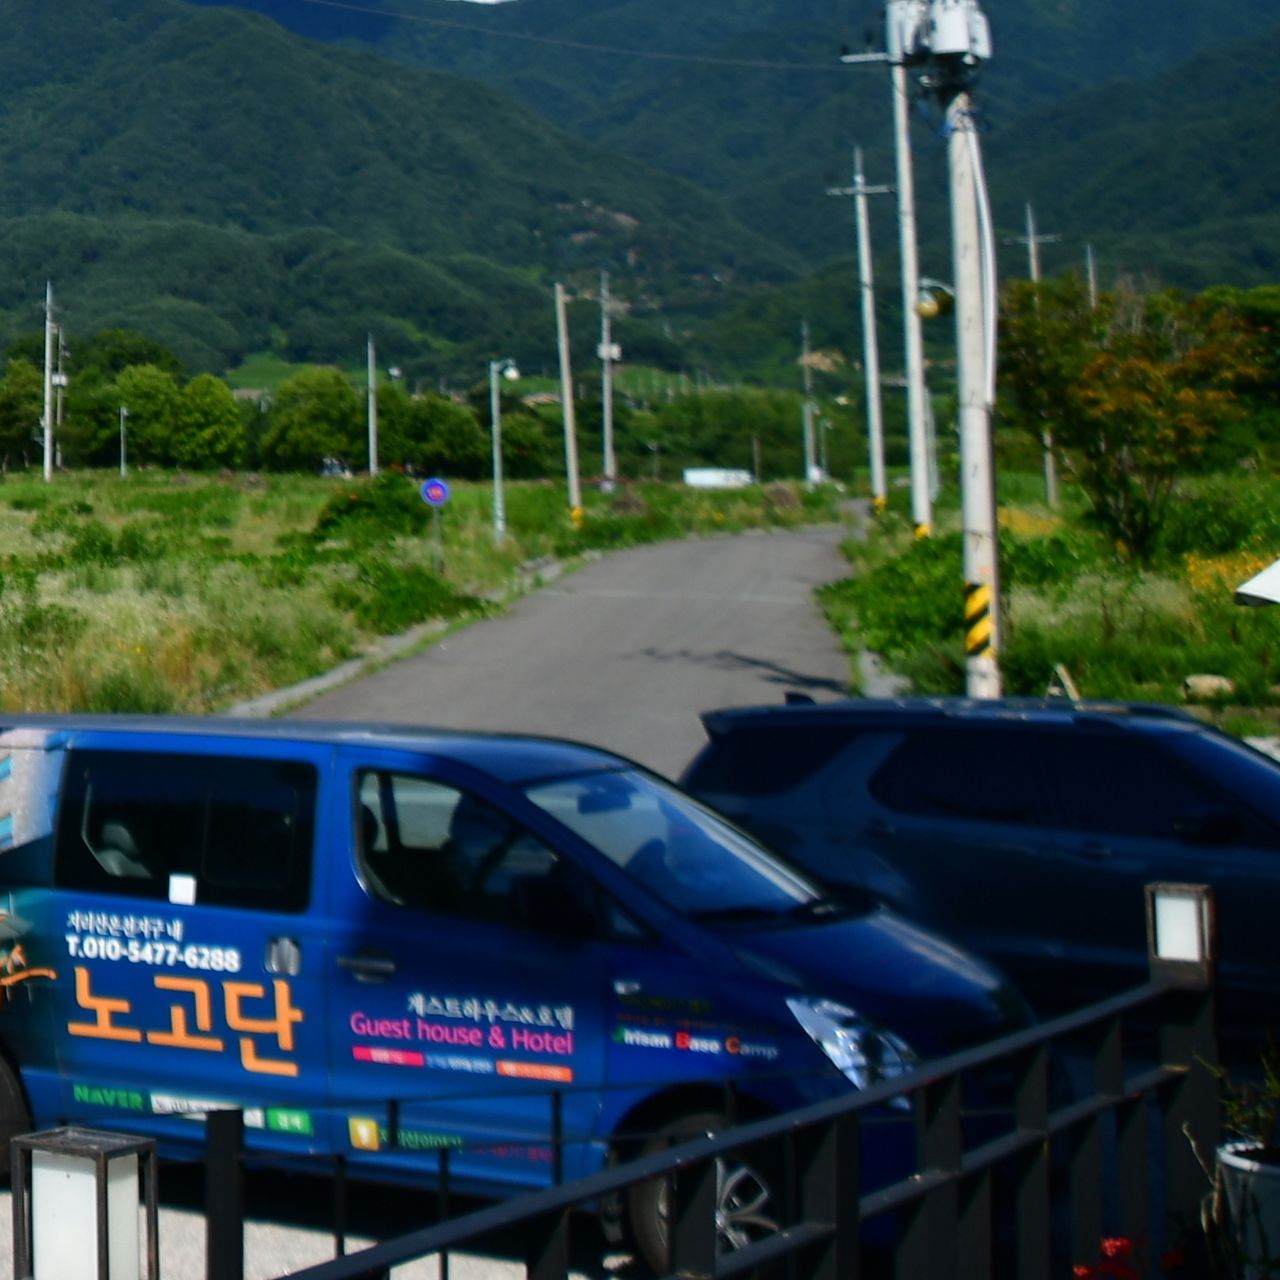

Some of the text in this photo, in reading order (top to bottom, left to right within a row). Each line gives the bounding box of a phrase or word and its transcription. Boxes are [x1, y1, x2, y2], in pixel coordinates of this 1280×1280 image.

[64, 933, 240, 973] T.010-5477-6288
[66, 966, 304, 1078] 노고단
[349, 1011, 574, 1055] Guest house & Hotel
[675, 1030, 721, 1055] Base
[725, 1035, 779, 1060] Camp
[73, 1083, 144, 1112] NAVER
